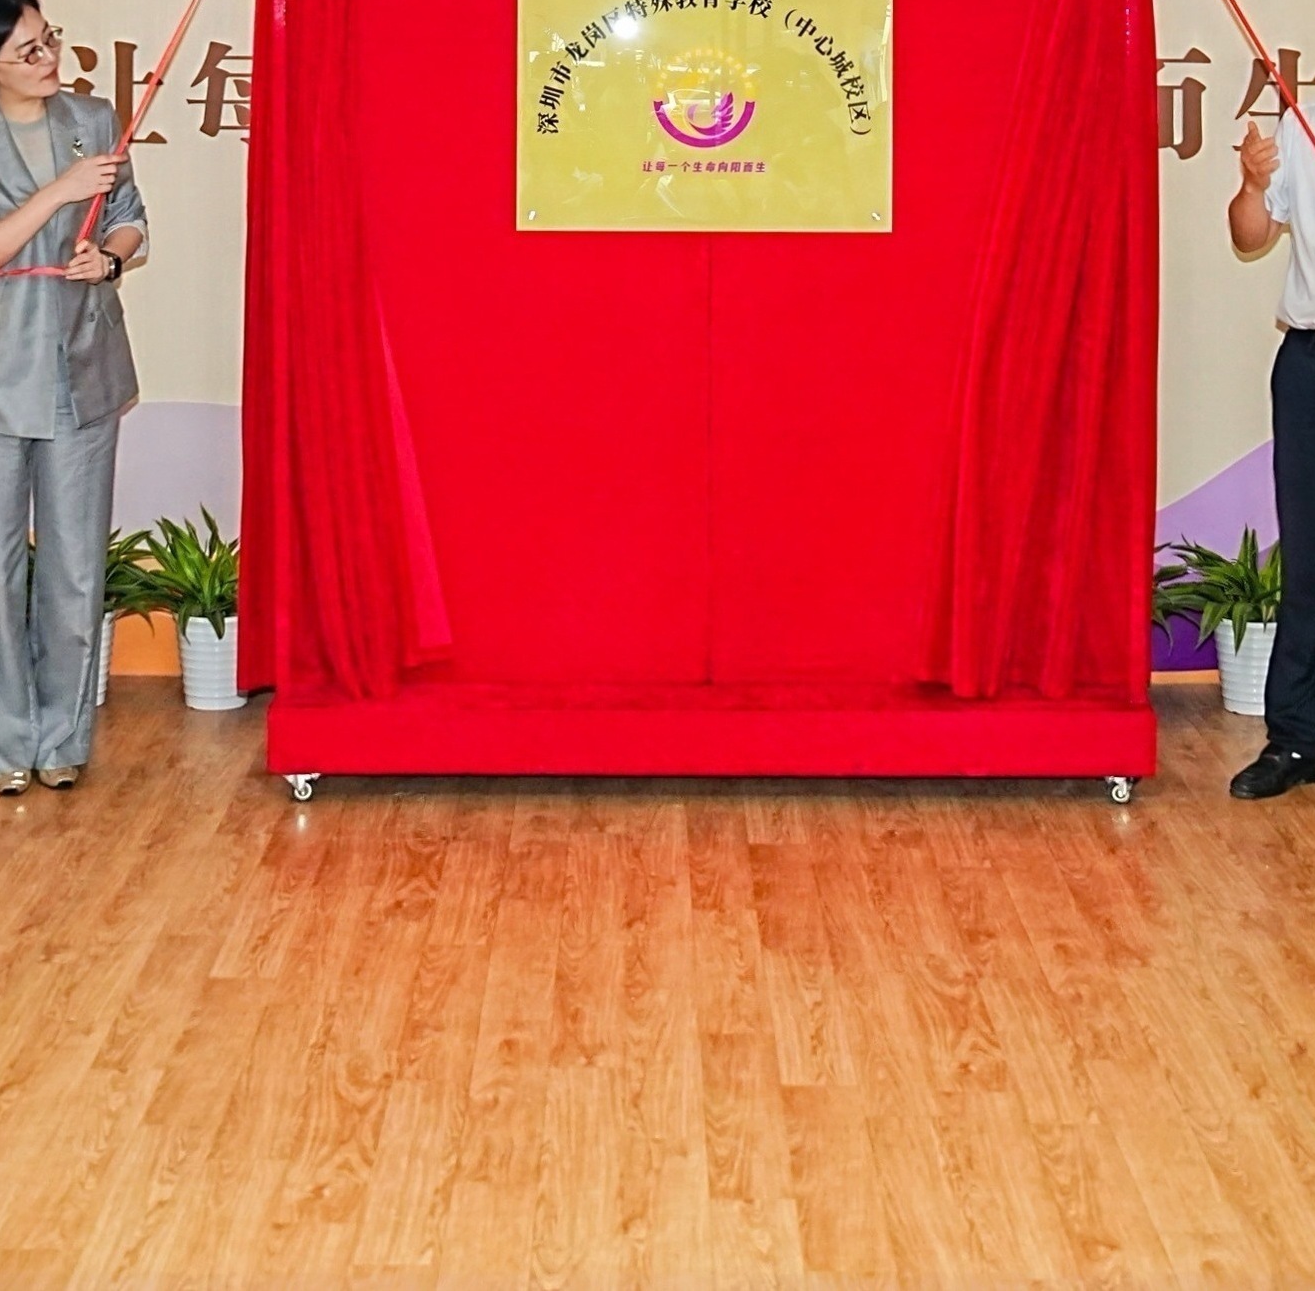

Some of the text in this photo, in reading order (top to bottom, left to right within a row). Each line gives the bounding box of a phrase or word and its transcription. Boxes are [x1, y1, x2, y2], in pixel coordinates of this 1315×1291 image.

[642, 161, 766, 173] 让每一个生命向阳而生
